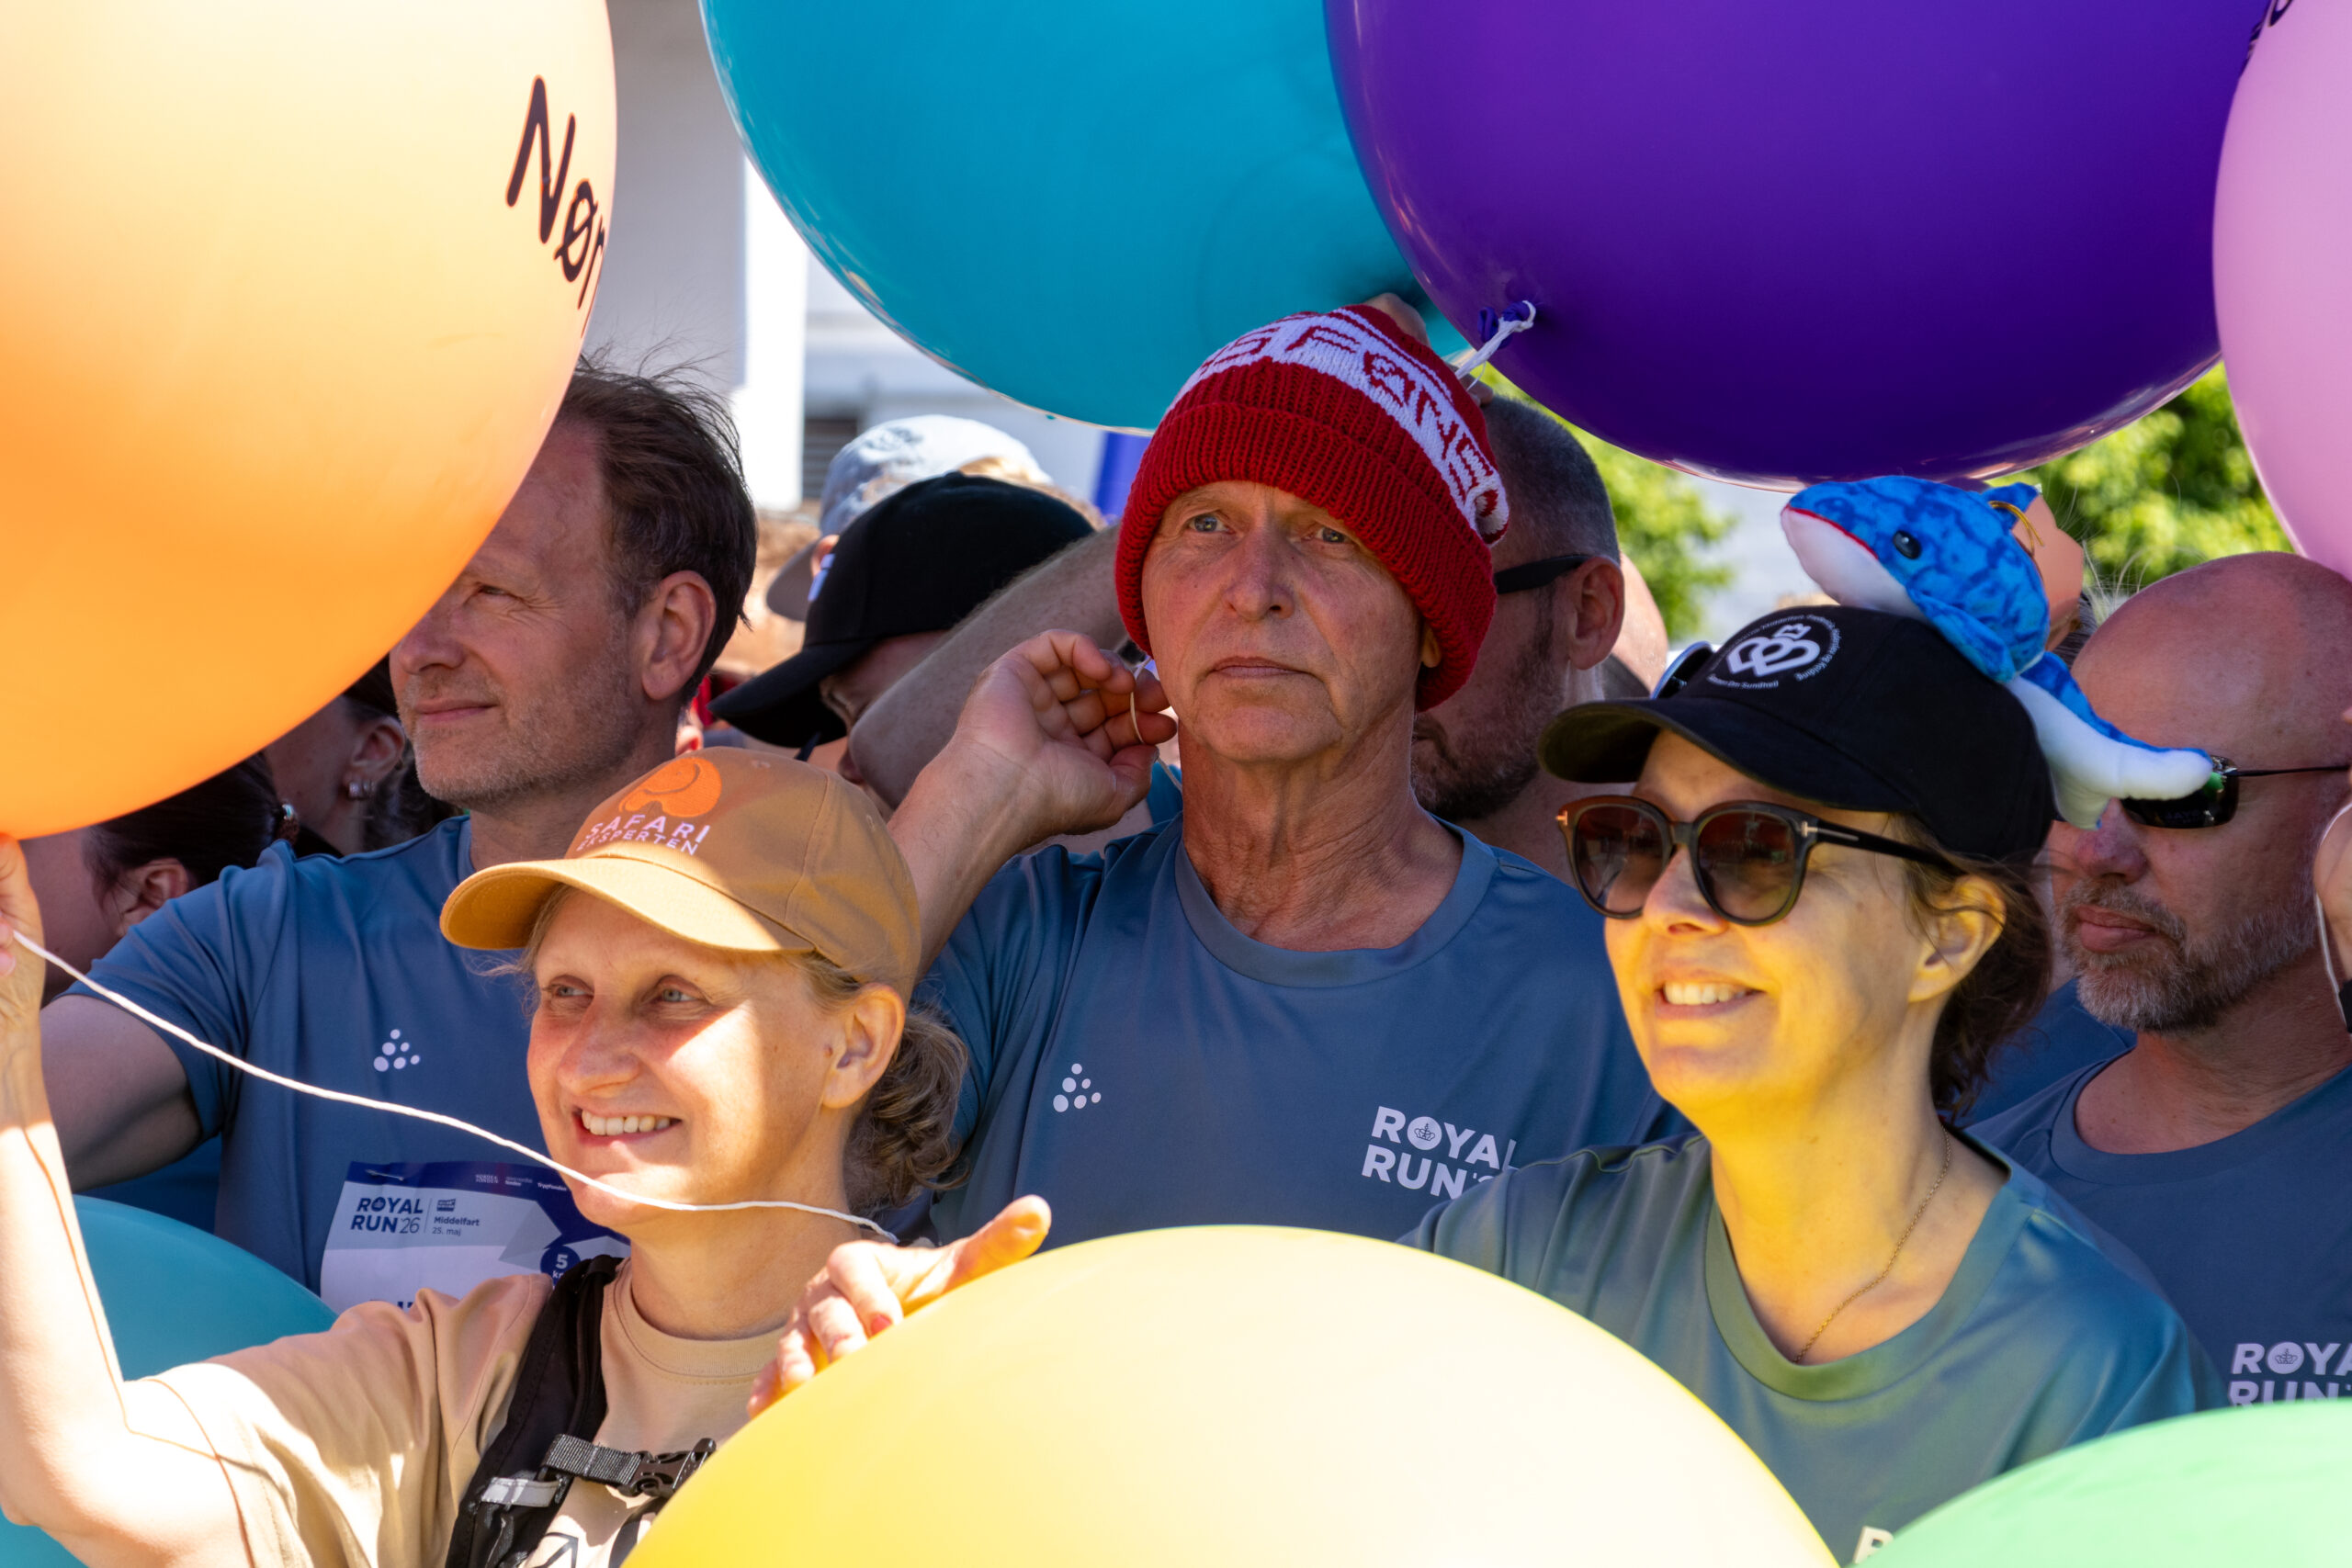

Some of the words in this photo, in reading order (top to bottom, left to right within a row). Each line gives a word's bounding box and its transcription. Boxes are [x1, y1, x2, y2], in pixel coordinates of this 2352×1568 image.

[505, 75, 605, 321] Nør
[586, 814, 710, 843] SAFARI
[576, 829, 698, 856] EKSPERTEN
[356, 1197, 424, 1213] ROYAL
[433, 1215, 480, 1226] Middelfart
[446, 1228, 461, 1236] maj
[555, 1253, 568, 1269] 5
